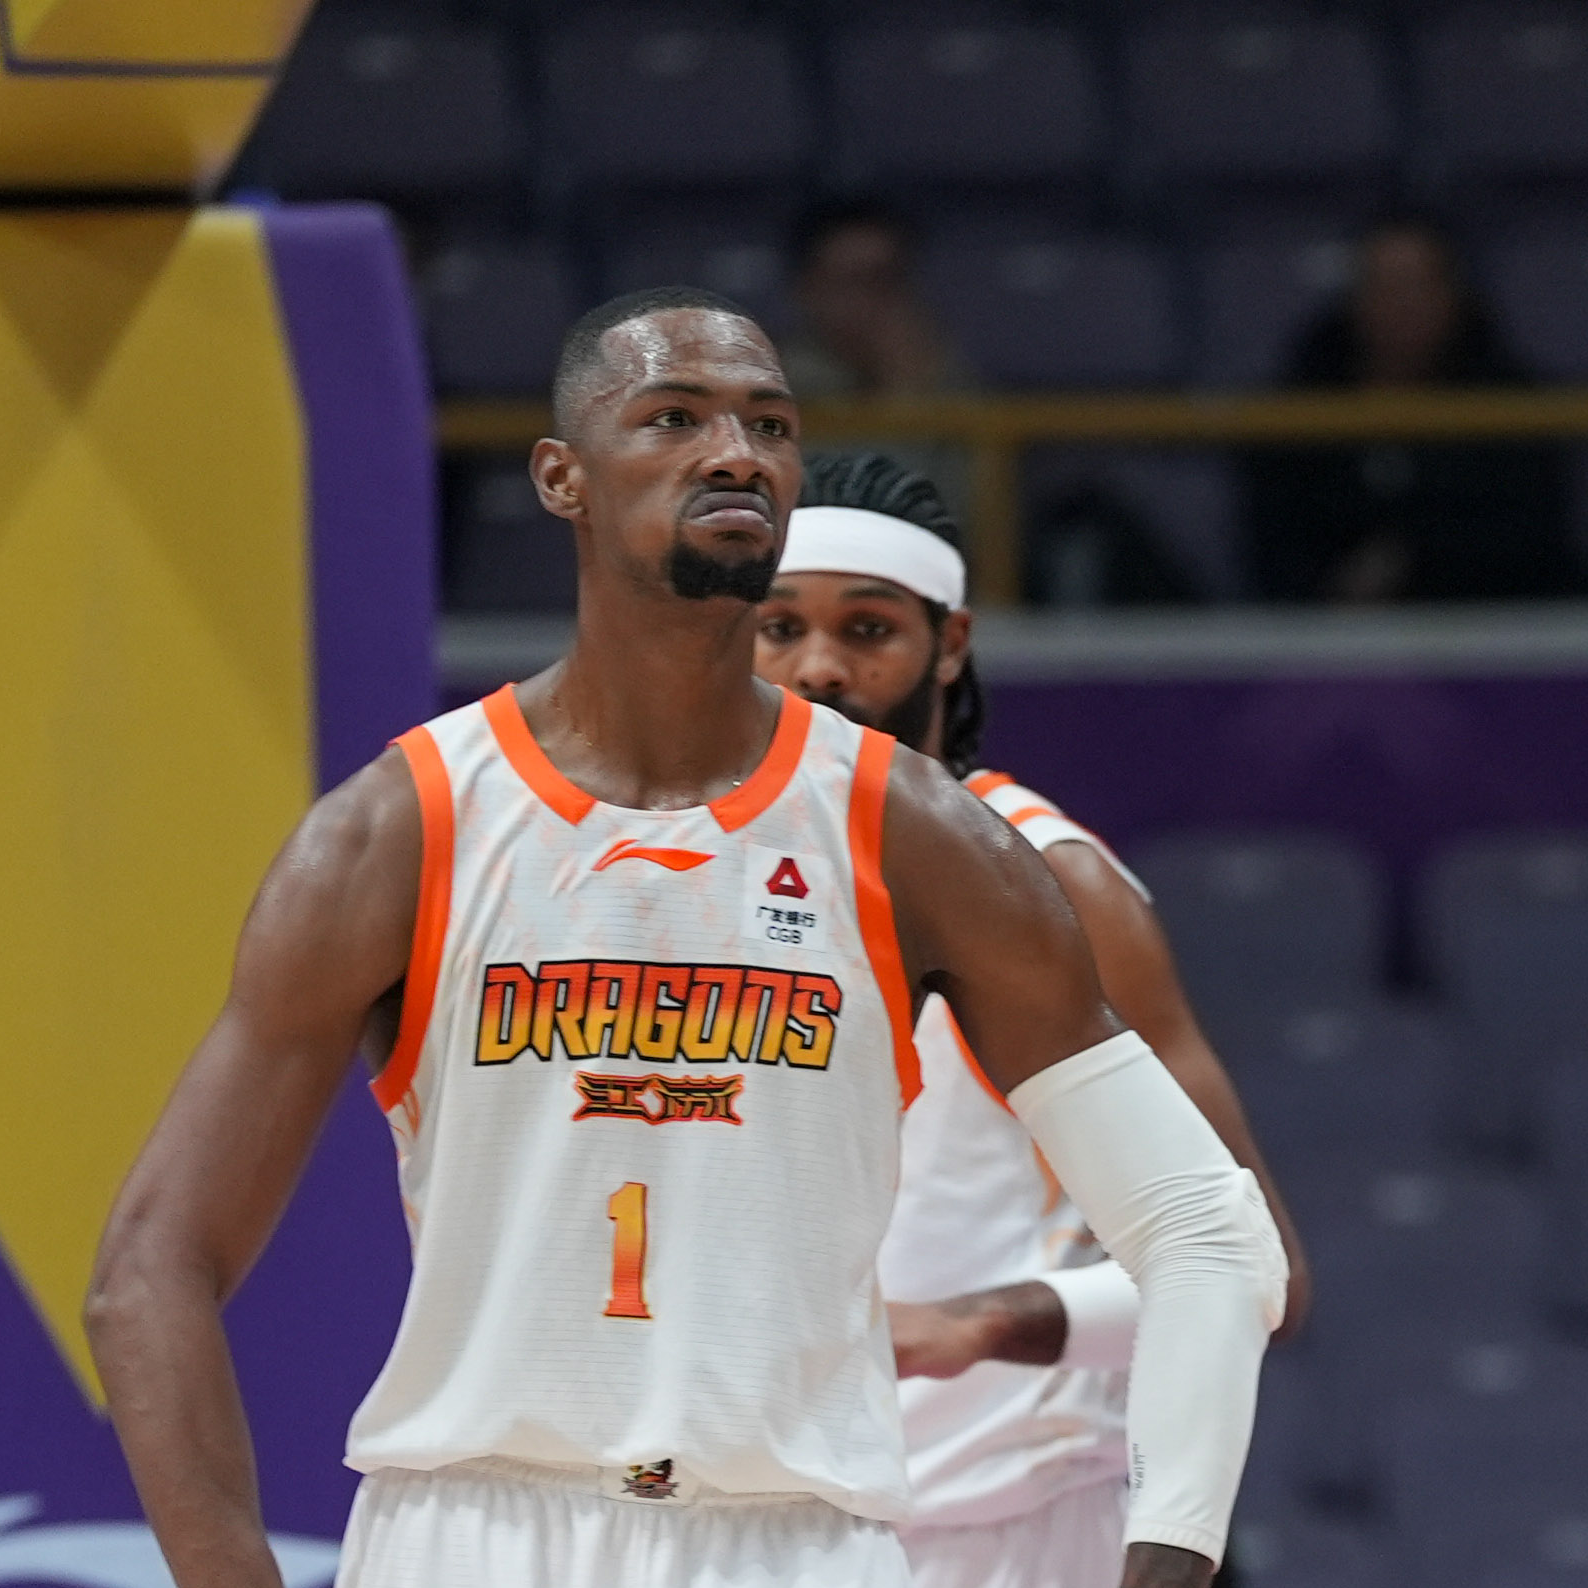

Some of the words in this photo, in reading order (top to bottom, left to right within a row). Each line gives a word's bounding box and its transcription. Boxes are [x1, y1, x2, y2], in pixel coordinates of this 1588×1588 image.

[766, 926, 802, 944] CGB
[474, 960, 842, 1070] DRAGONS
[602, 1182, 653, 1319] 1
